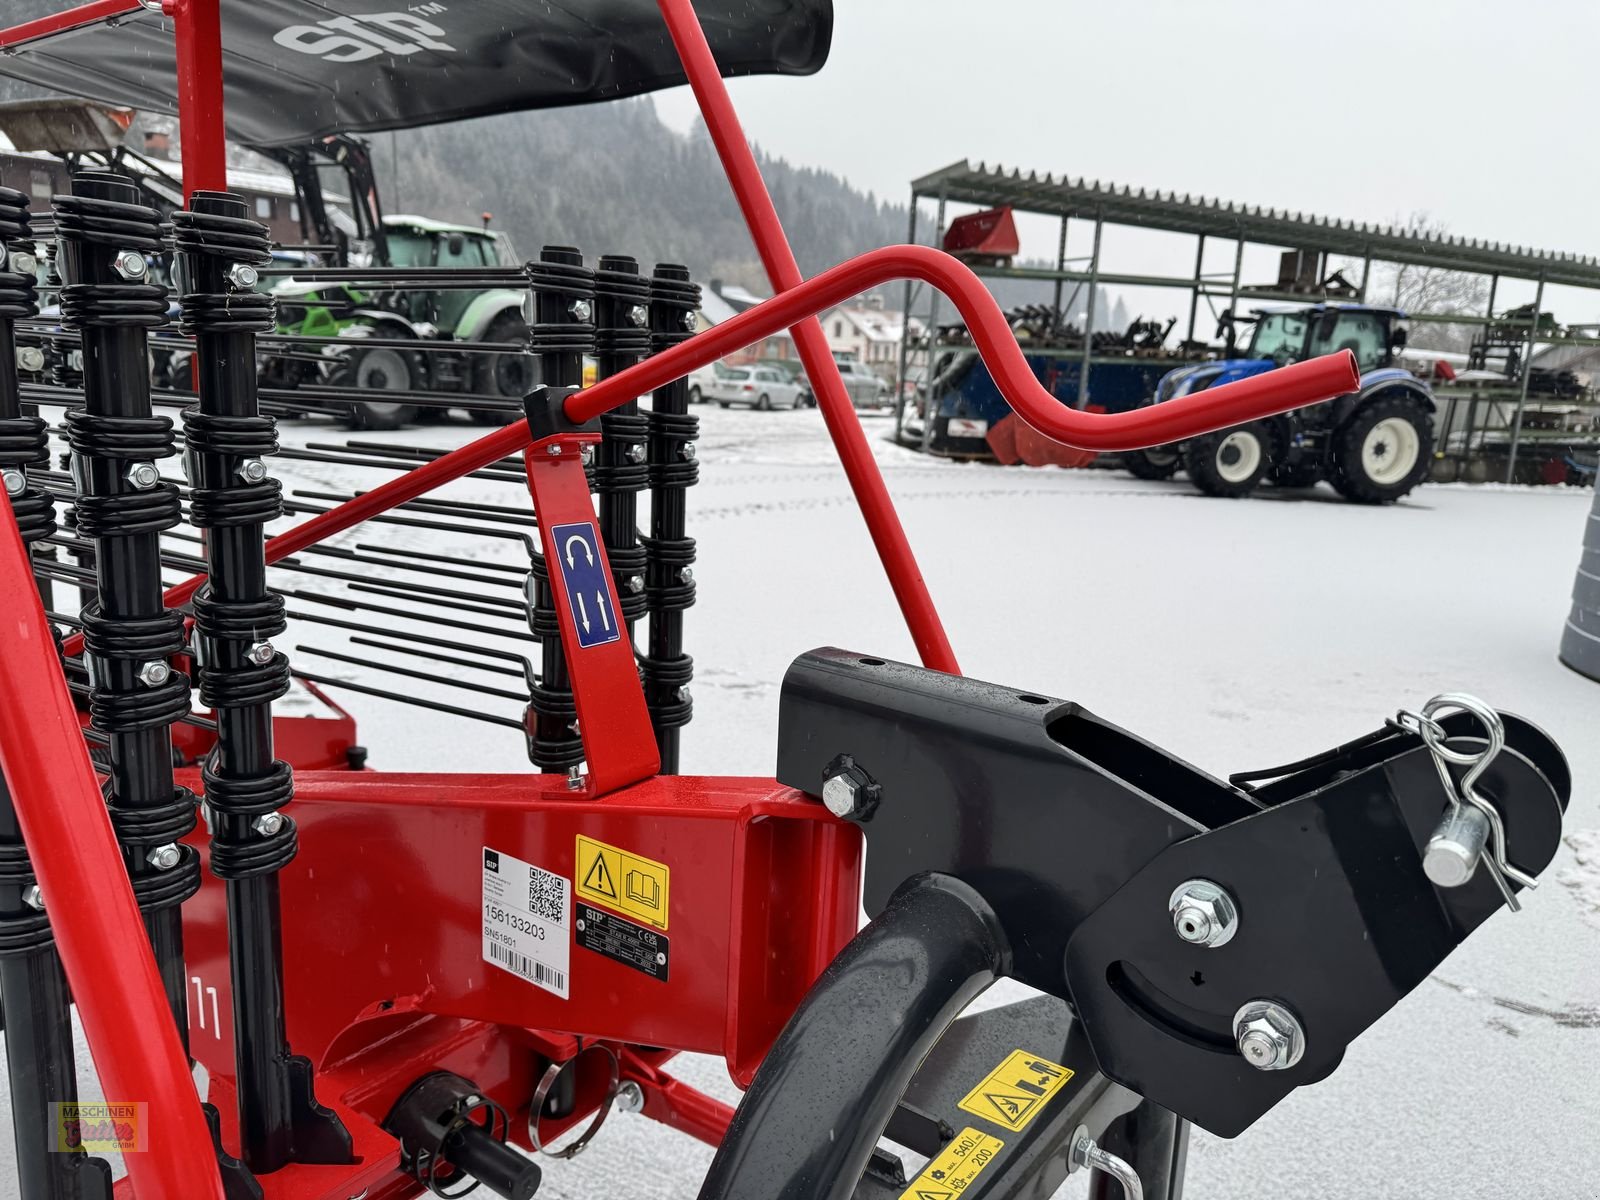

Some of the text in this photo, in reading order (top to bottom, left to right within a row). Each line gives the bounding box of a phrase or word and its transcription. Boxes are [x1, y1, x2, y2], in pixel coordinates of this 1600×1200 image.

[485, 904, 545, 941] 156133203
[586, 909, 603, 923] SIP
[484, 926, 516, 948] SN51801
[971, 1148, 993, 1167] 200
